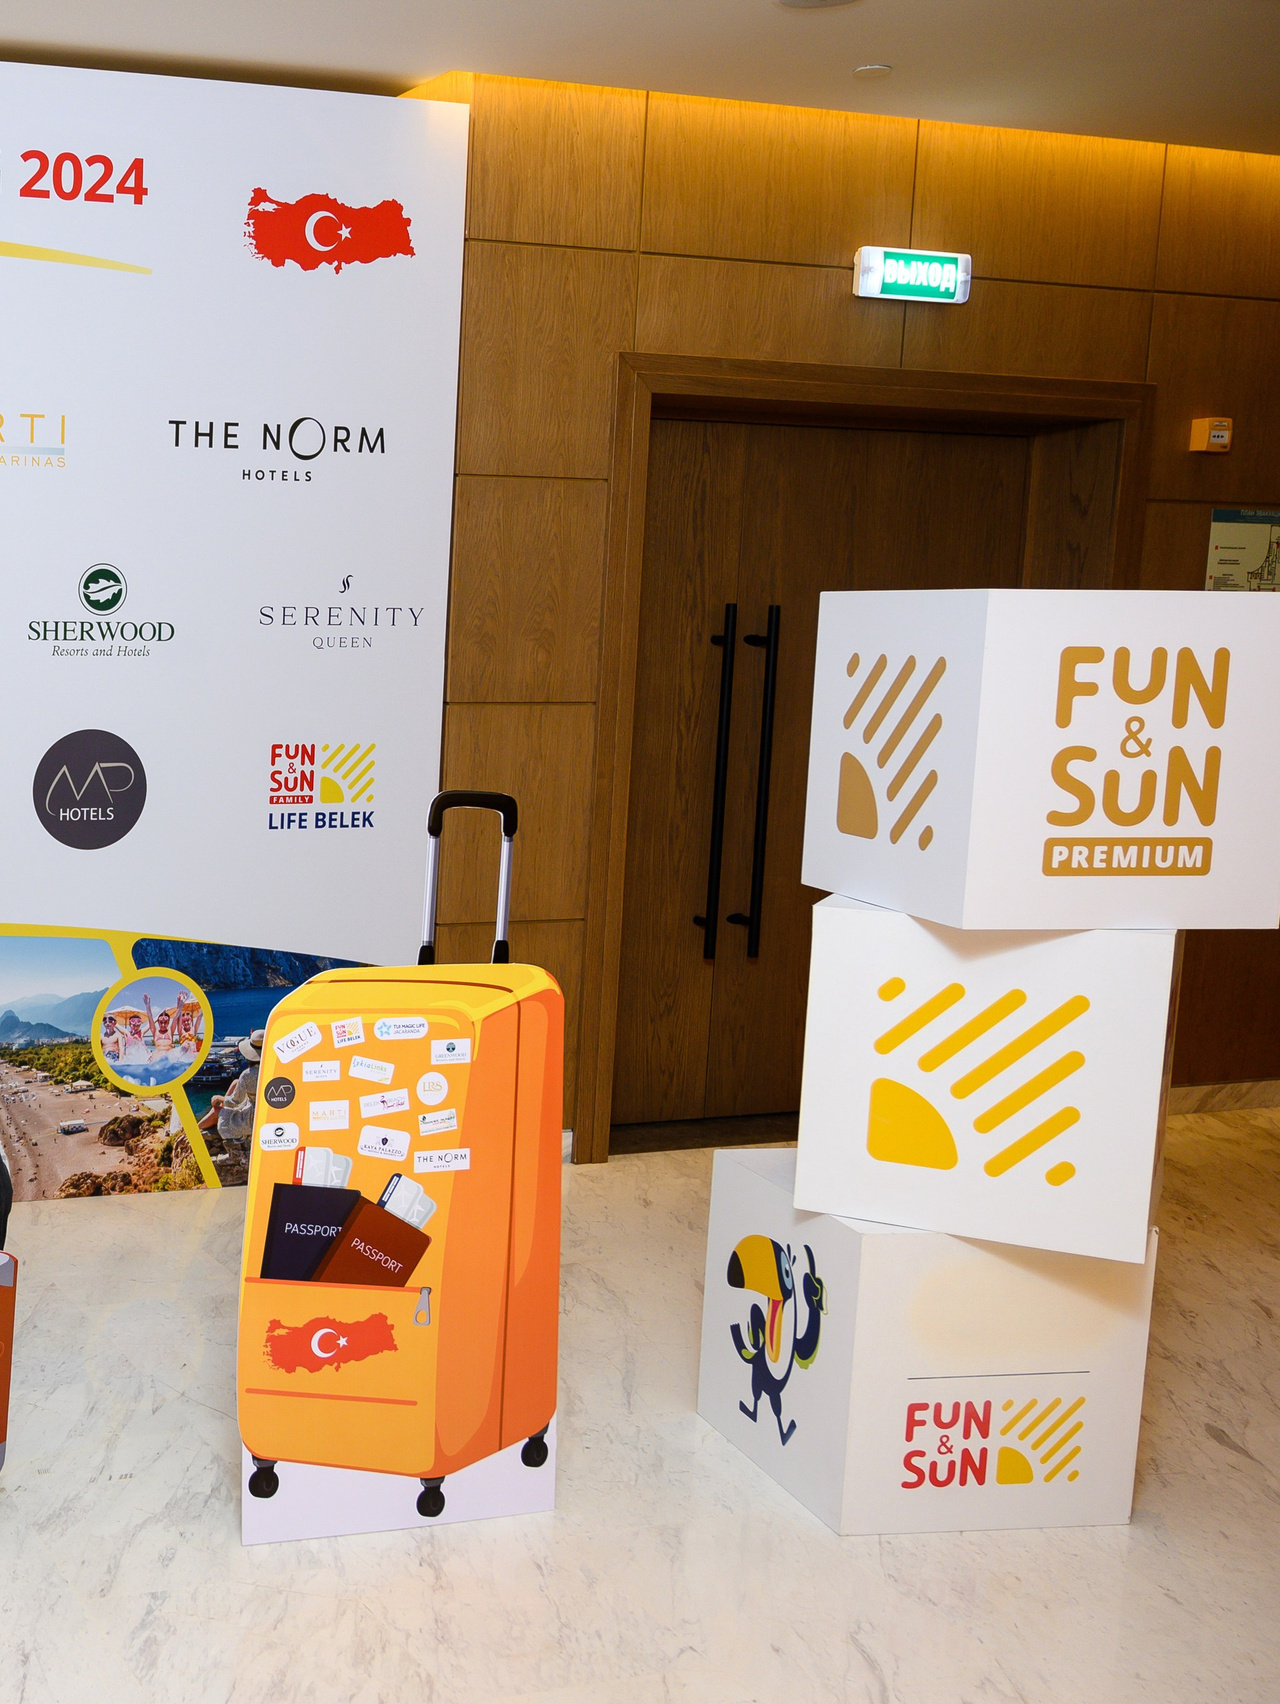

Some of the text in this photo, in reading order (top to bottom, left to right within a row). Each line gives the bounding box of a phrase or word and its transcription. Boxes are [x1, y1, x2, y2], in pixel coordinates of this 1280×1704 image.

[19, 149, 149, 206] 2024
[884, 258, 956, 293] ВЫХОД
[168, 416, 386, 461] THE NORM
[242, 469, 313, 483] HOTELS
[258, 605, 426, 628] SERENITY
[27, 620, 176, 642] SHERWOOD
[51, 645, 151, 657] Resorts and Hotels
[311, 636, 373, 650] QUEEN
[1055, 645, 1231, 729] FUN
[1119, 715, 1153, 758] &
[270, 743, 316, 767] FUN
[287, 761, 297, 775] &
[269, 769, 315, 793] SUN
[1046, 745, 1222, 827] SUN
[272, 796, 310, 804] FAMILY
[59, 806, 115, 822] HOTELS
[268, 810, 375, 830] LIFE BELEK
[1050, 844, 1205, 869] PREMIUM
[277, 1026, 317, 1054] VOGUE
[312, 1109, 347, 1117] MARTI
[261, 1137, 298, 1146] SHERWOOD
[417, 1152, 467, 1164] THE NORM
[351, 1237, 404, 1274] PASSPORT
[904, 1400, 992, 1442] FUN
[936, 1434, 954, 1456] &
[901, 1447, 989, 1489] SUN
